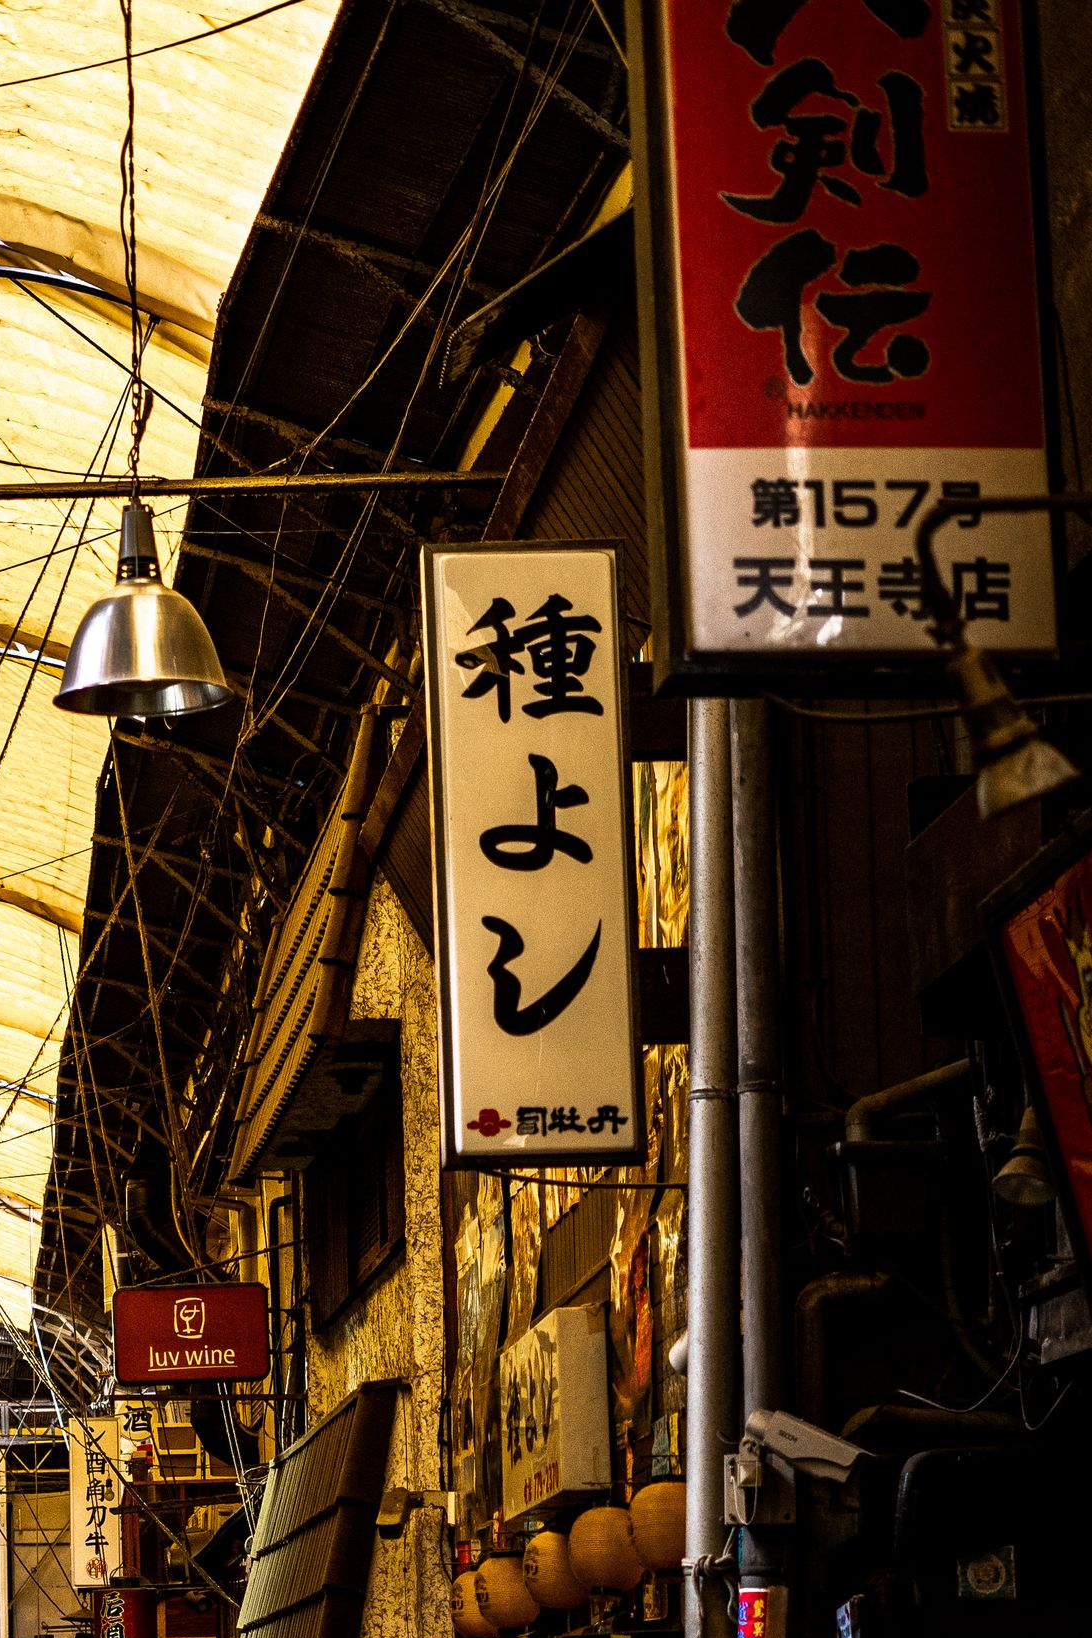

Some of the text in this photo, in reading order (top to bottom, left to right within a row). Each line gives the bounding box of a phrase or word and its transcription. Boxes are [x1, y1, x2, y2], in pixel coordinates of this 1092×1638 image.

[750, 478, 983, 529] 第157号
[148, 1345, 236, 1368] luv wine
[123, 1405, 154, 1432] 酒
